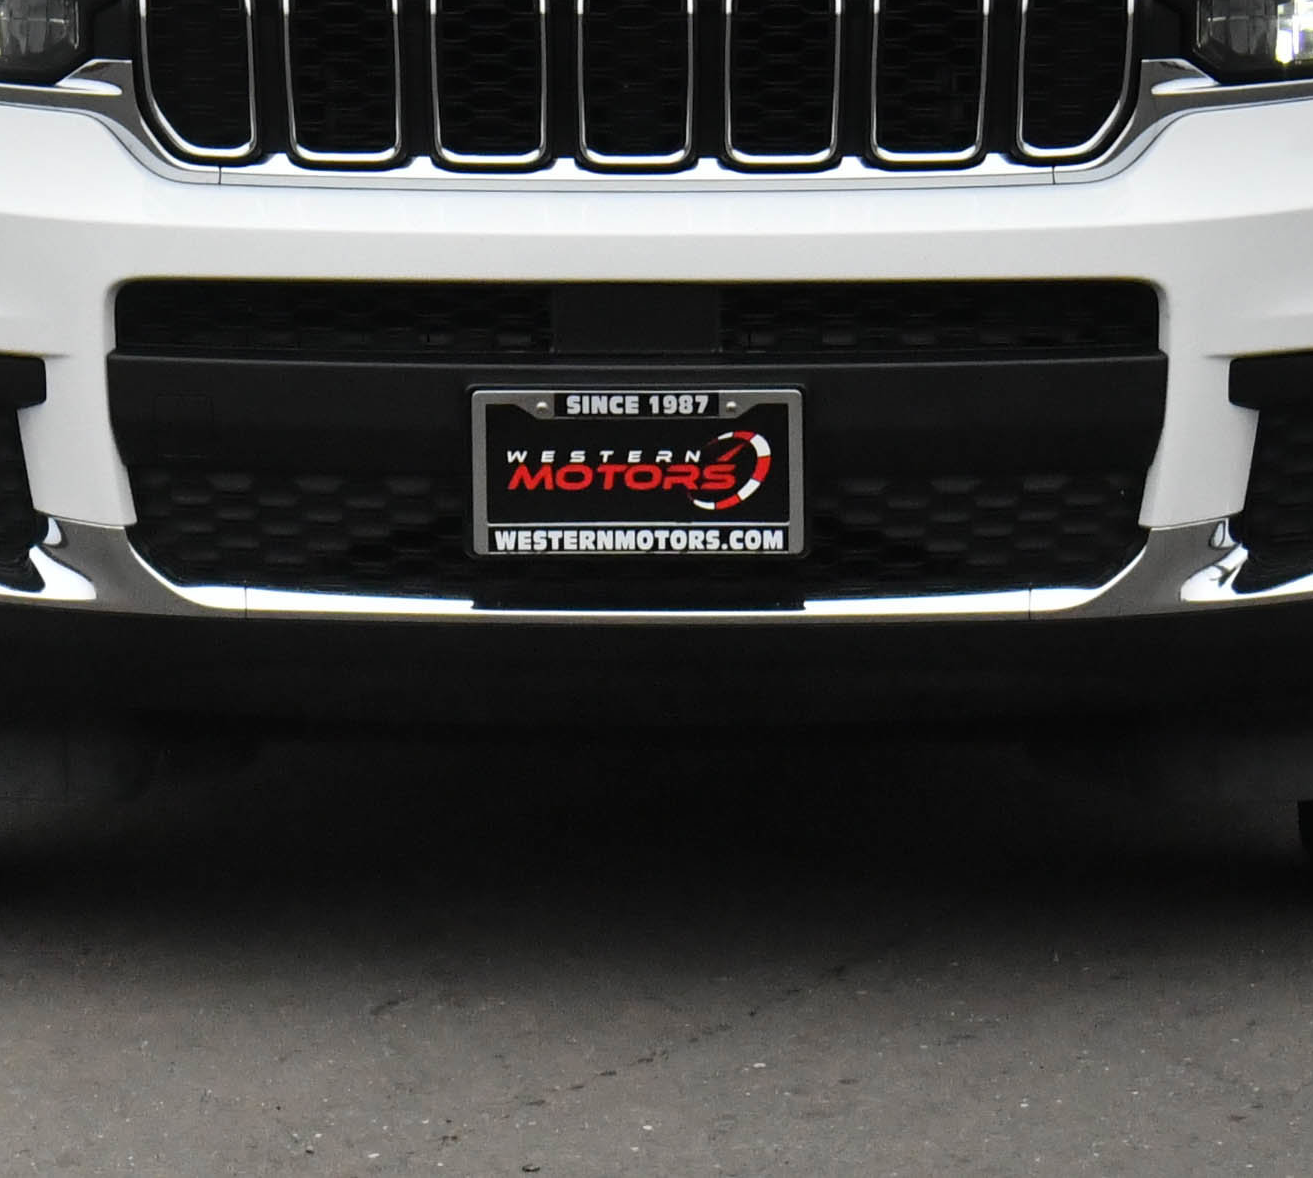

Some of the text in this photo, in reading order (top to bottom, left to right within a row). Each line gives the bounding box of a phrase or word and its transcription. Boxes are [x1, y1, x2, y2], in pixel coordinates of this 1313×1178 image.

[566, 395, 709, 415] SINCE 1987
[506, 449, 702, 464] WESTERN
[507, 463, 737, 491] MOTORS
[495, 530, 784, 552] WESTERNMOTORS.COM
